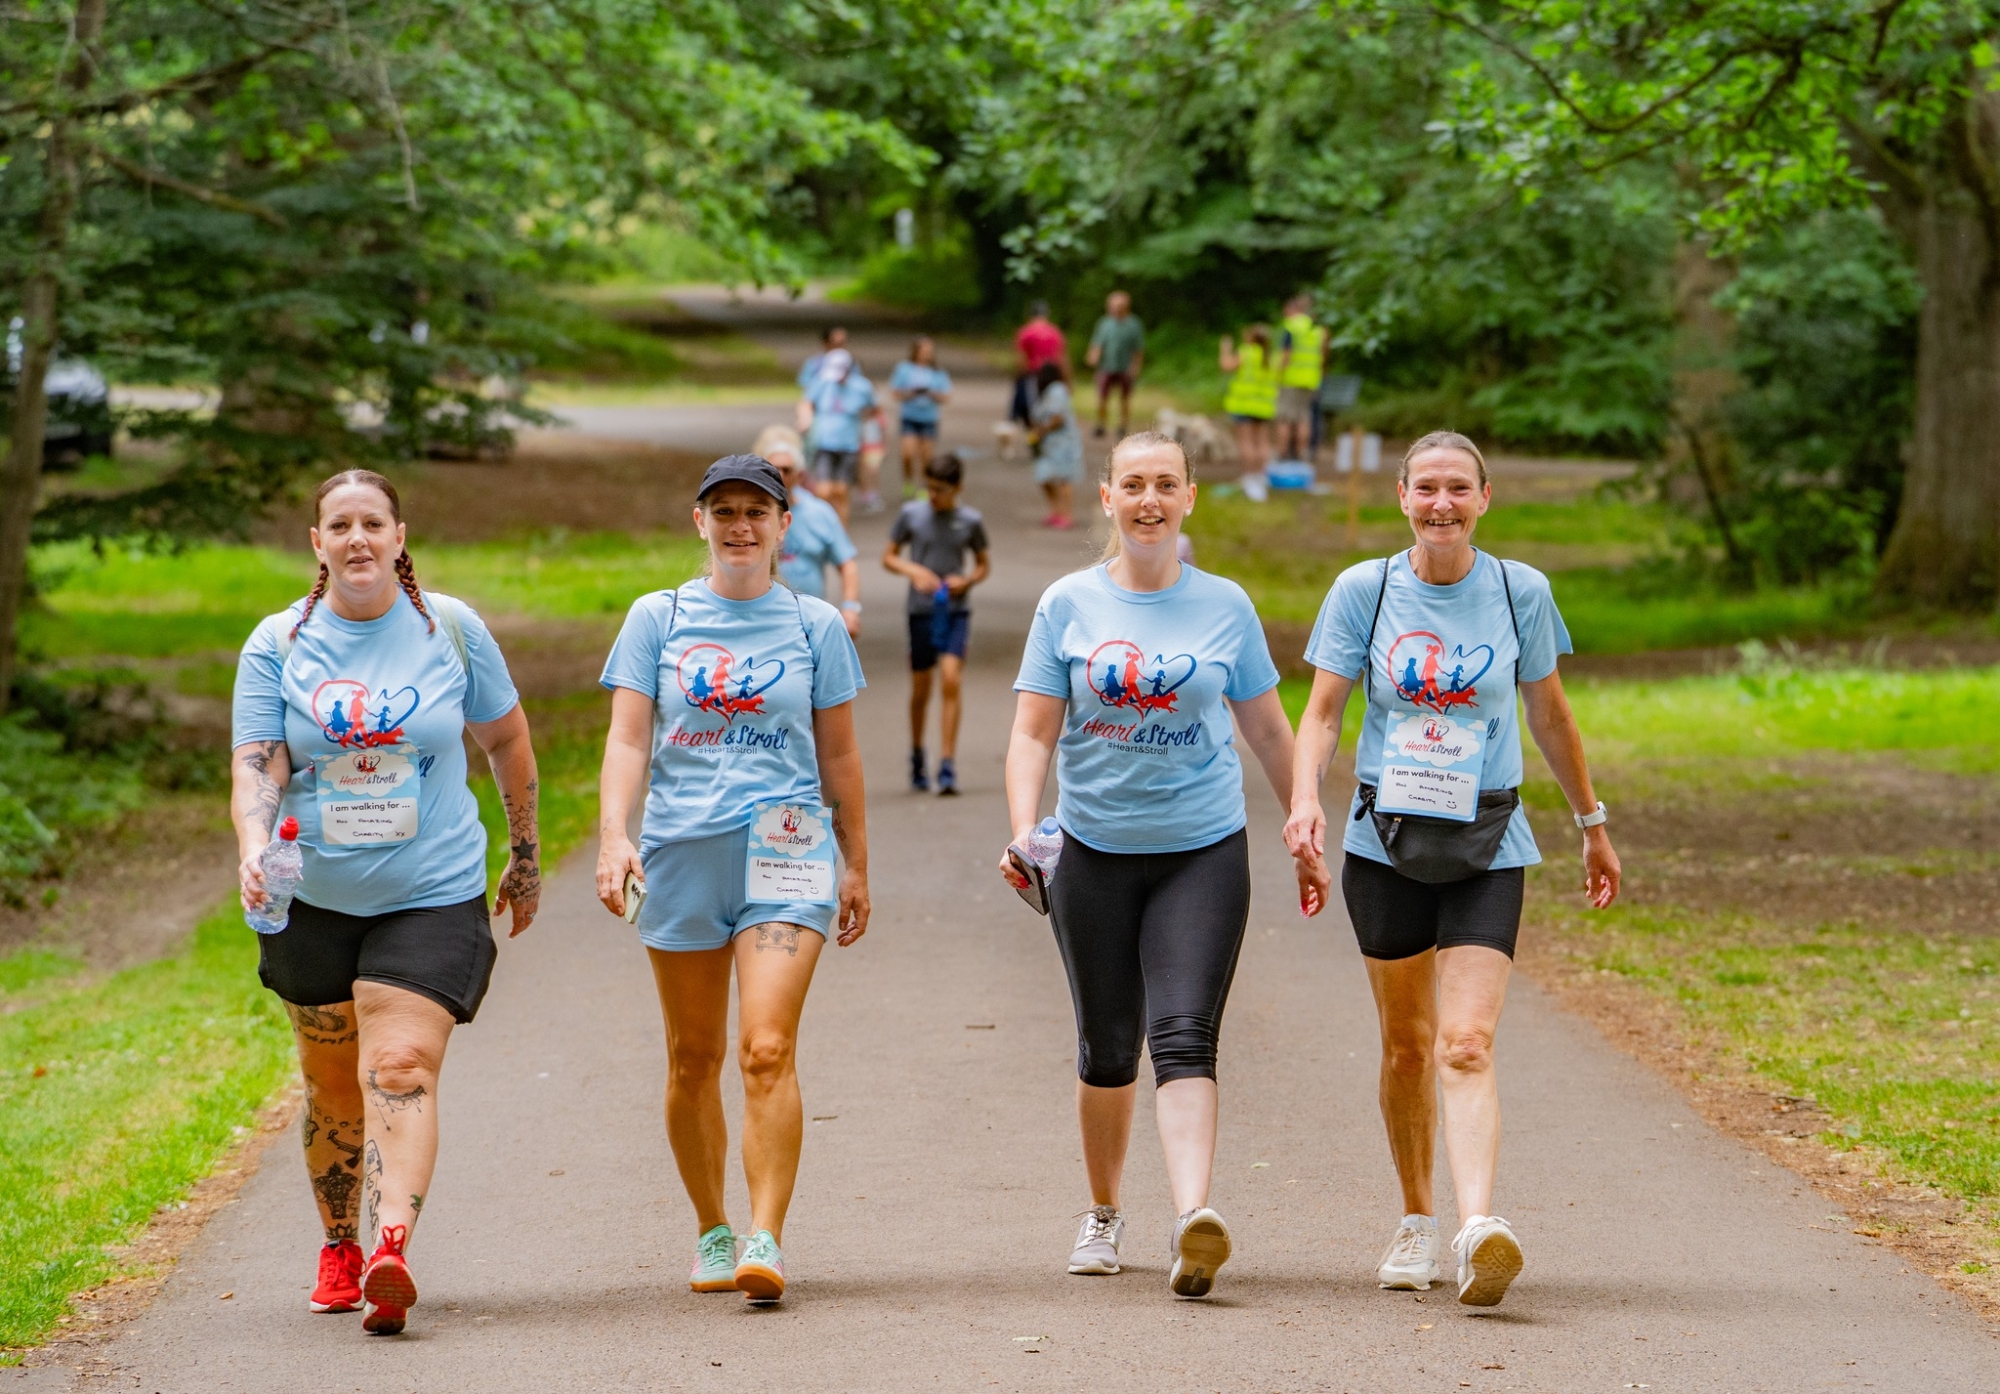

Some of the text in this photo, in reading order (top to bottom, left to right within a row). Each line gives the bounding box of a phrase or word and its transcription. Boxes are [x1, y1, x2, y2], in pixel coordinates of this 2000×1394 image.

[698, 746, 758, 754] #Heart&Stroll
[1107, 742, 1168, 756] #Heart&Stroll
[1410, 770, 1444, 782] walking
[1446, 772, 1460, 782] for
[352, 802, 385, 811] walking
[773, 861, 802, 871] walking
[804, 862, 815, 870] for
